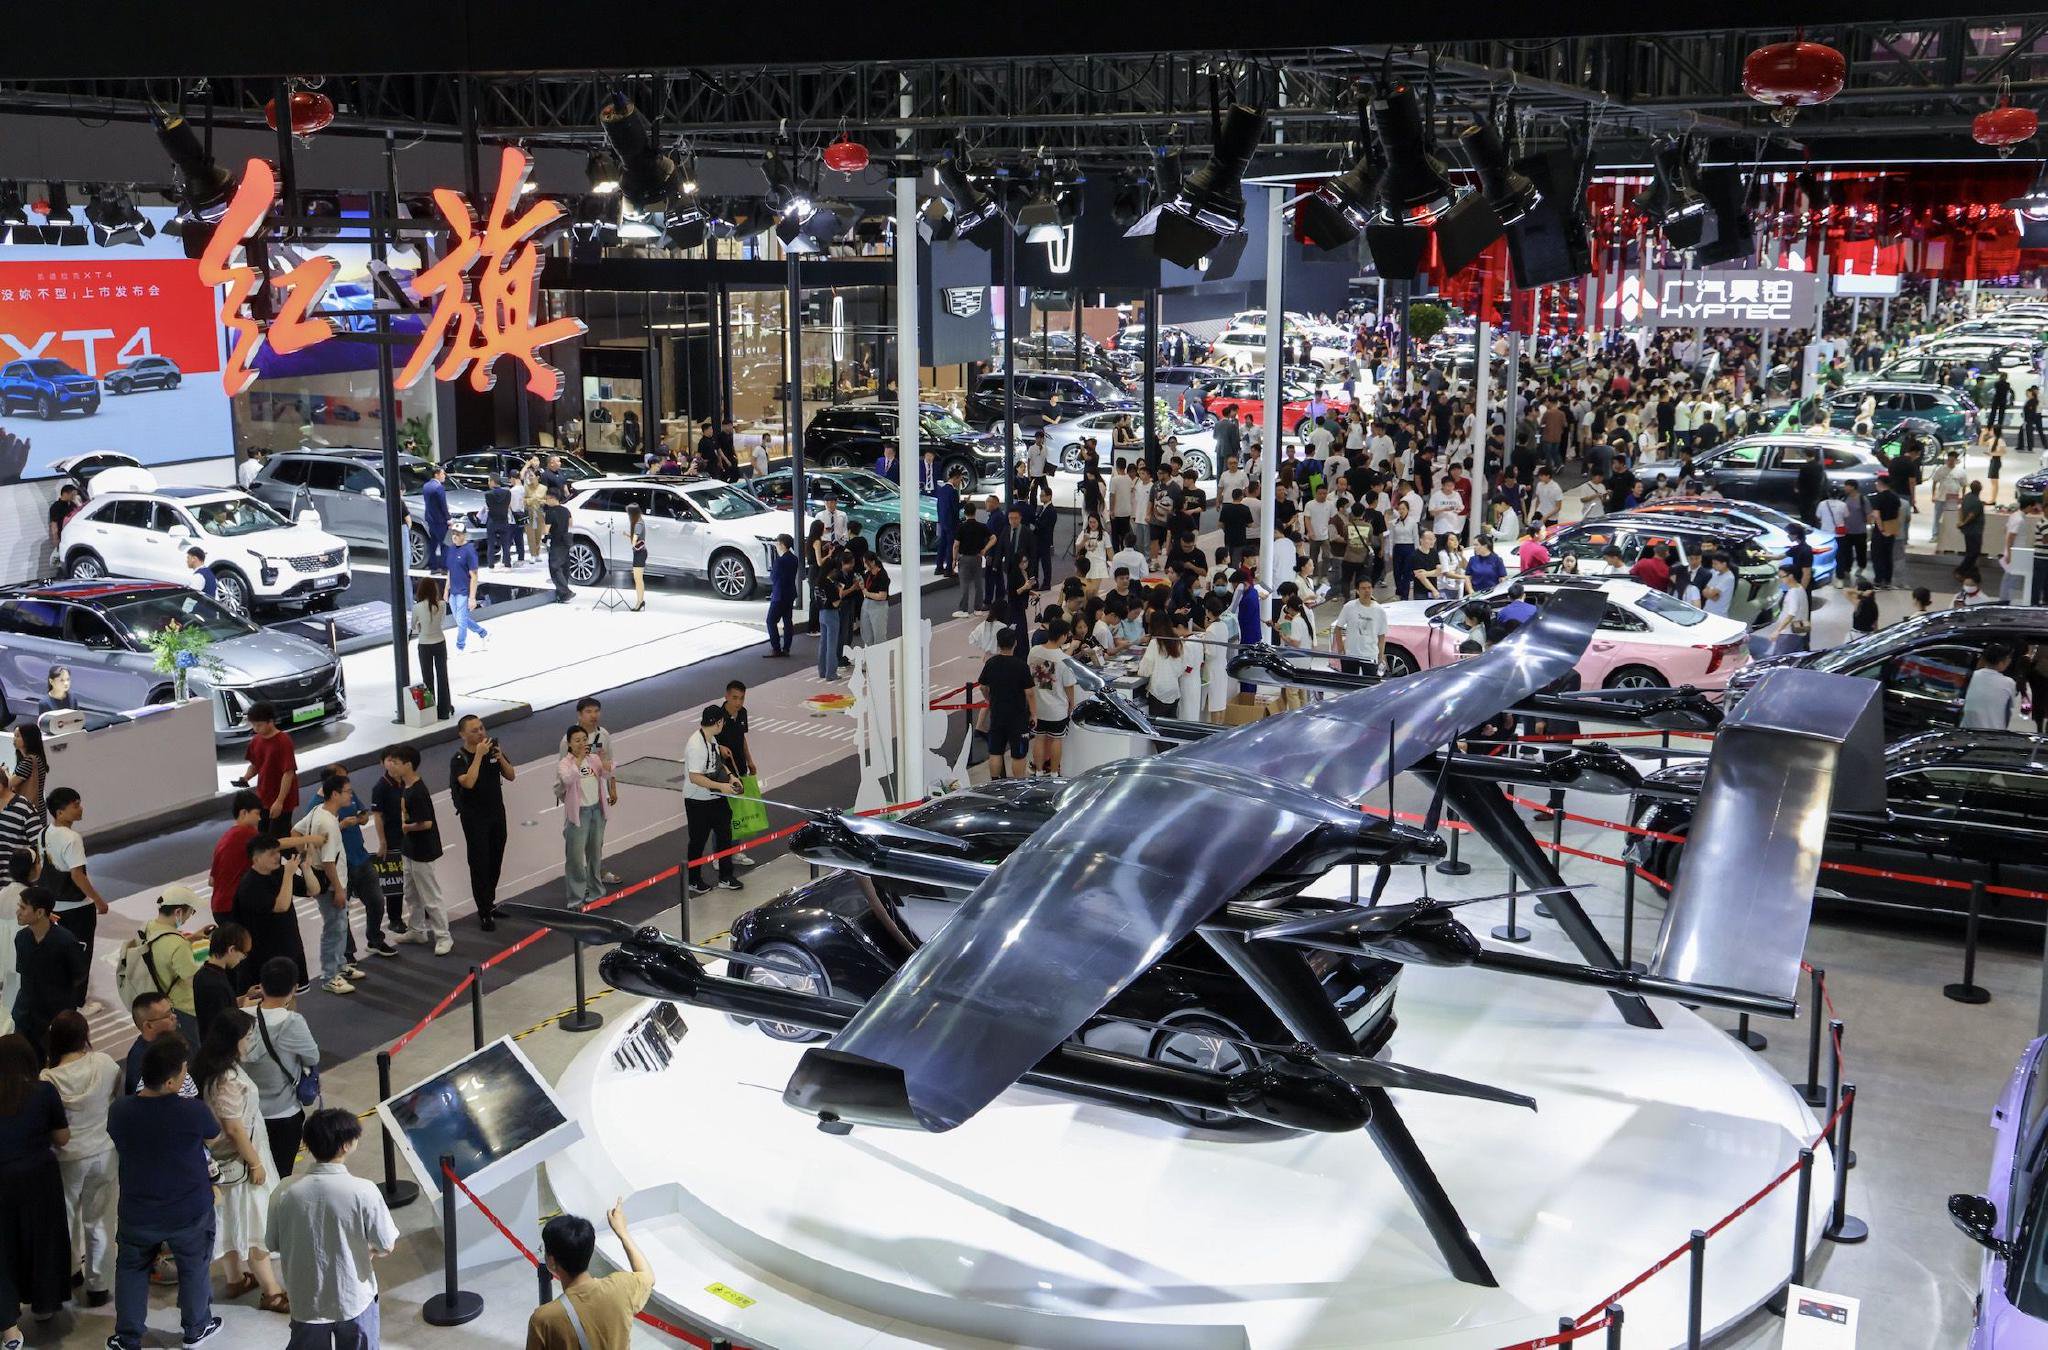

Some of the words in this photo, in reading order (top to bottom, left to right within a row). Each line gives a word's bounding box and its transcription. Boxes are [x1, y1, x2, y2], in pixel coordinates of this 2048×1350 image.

[199, 147, 588, 401] 红旗
[1660, 303, 1791, 320] HYPTEC
[0, 326, 161, 376] XT4
